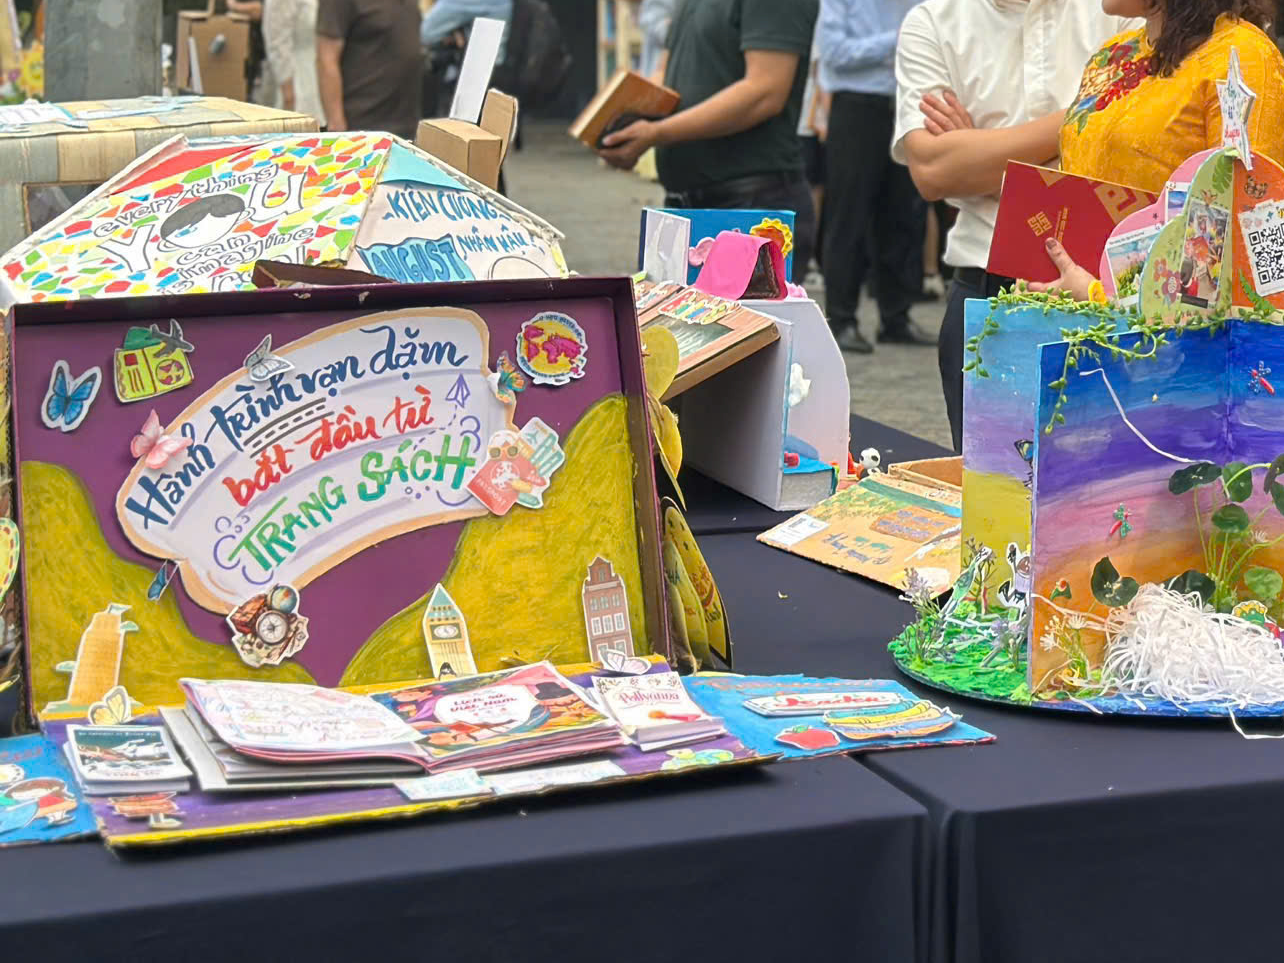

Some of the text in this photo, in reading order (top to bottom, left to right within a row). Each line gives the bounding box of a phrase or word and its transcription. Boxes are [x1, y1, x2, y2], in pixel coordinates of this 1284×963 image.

[94, 163, 279, 238] everything
[175, 227, 314, 280] imagine
[176, 233, 251, 266] can
[370, 241, 466, 283] AUGUST
[125, 422, 216, 530] Hành
[295, 355, 365, 397] vạn
[359, 325, 469, 380] dặm
[293, 405, 382, 461] đầu
[227, 434, 477, 571] TRANG SÁCH
